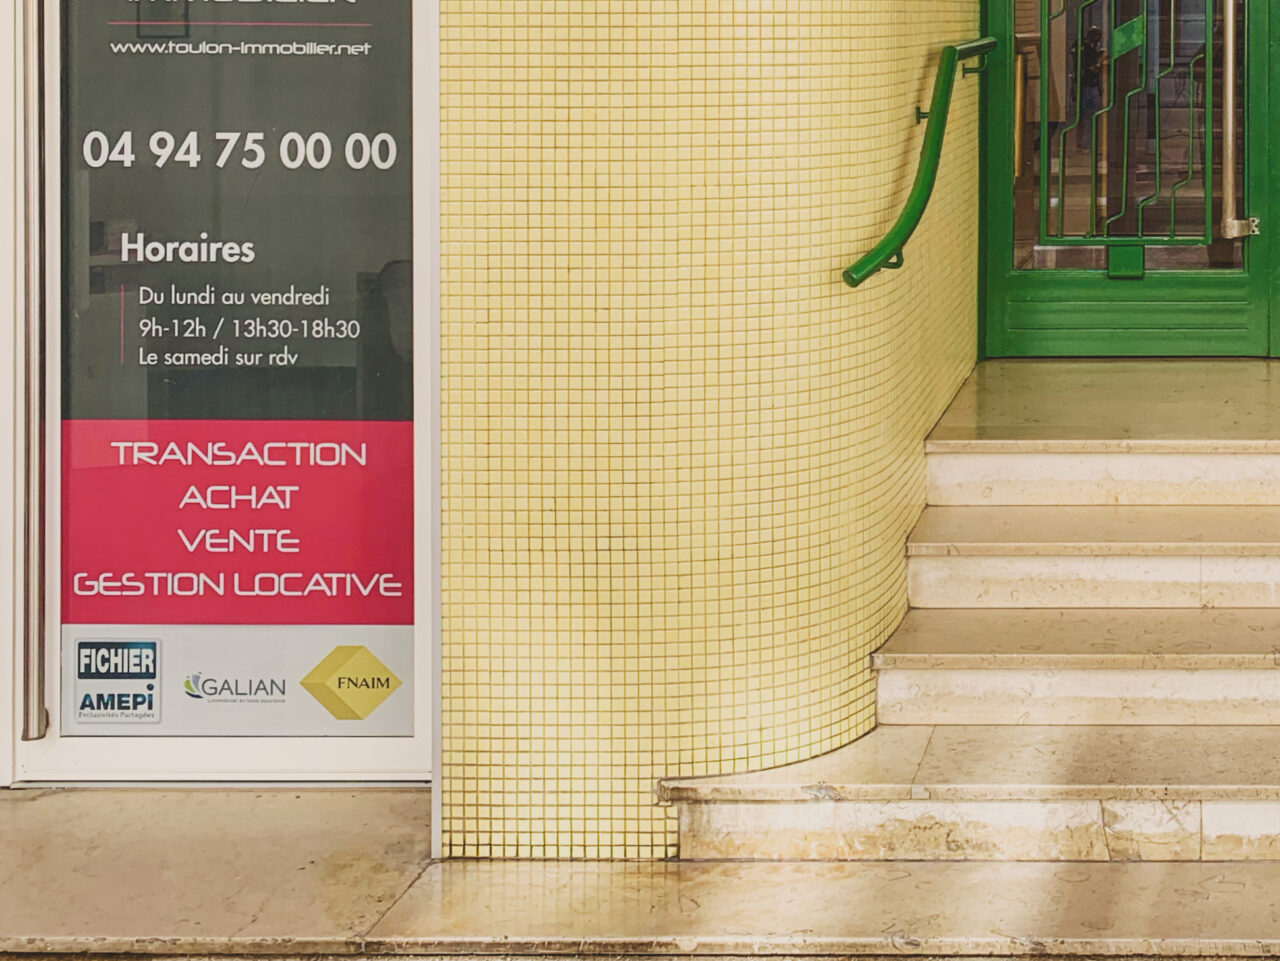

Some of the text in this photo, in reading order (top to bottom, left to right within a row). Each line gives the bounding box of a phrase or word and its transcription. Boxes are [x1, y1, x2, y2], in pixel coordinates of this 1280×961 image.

[110, 41, 372, 56] www.toulon-immobilier.net
[82, 131, 397, 170] 04 94 75 00 00
[121, 232, 256, 263] Horaires
[139, 284, 330, 306] Du lundi au vendredi
[139, 317, 207, 338] 9h-12h
[233, 317, 361, 339] 13h30-18h30
[139, 345, 299, 366] Le samedi sur rdv
[110, 442, 367, 467] TRANSACTION
[178, 485, 299, 509] ACHAT
[177, 528, 300, 553] VENTE
[73, 572, 402, 597] GESTION LOCATIVE
[80, 648, 154, 673] FICHIER
[201, 678, 286, 696] GALIAN
[338, 677, 390, 689] FNAIM
